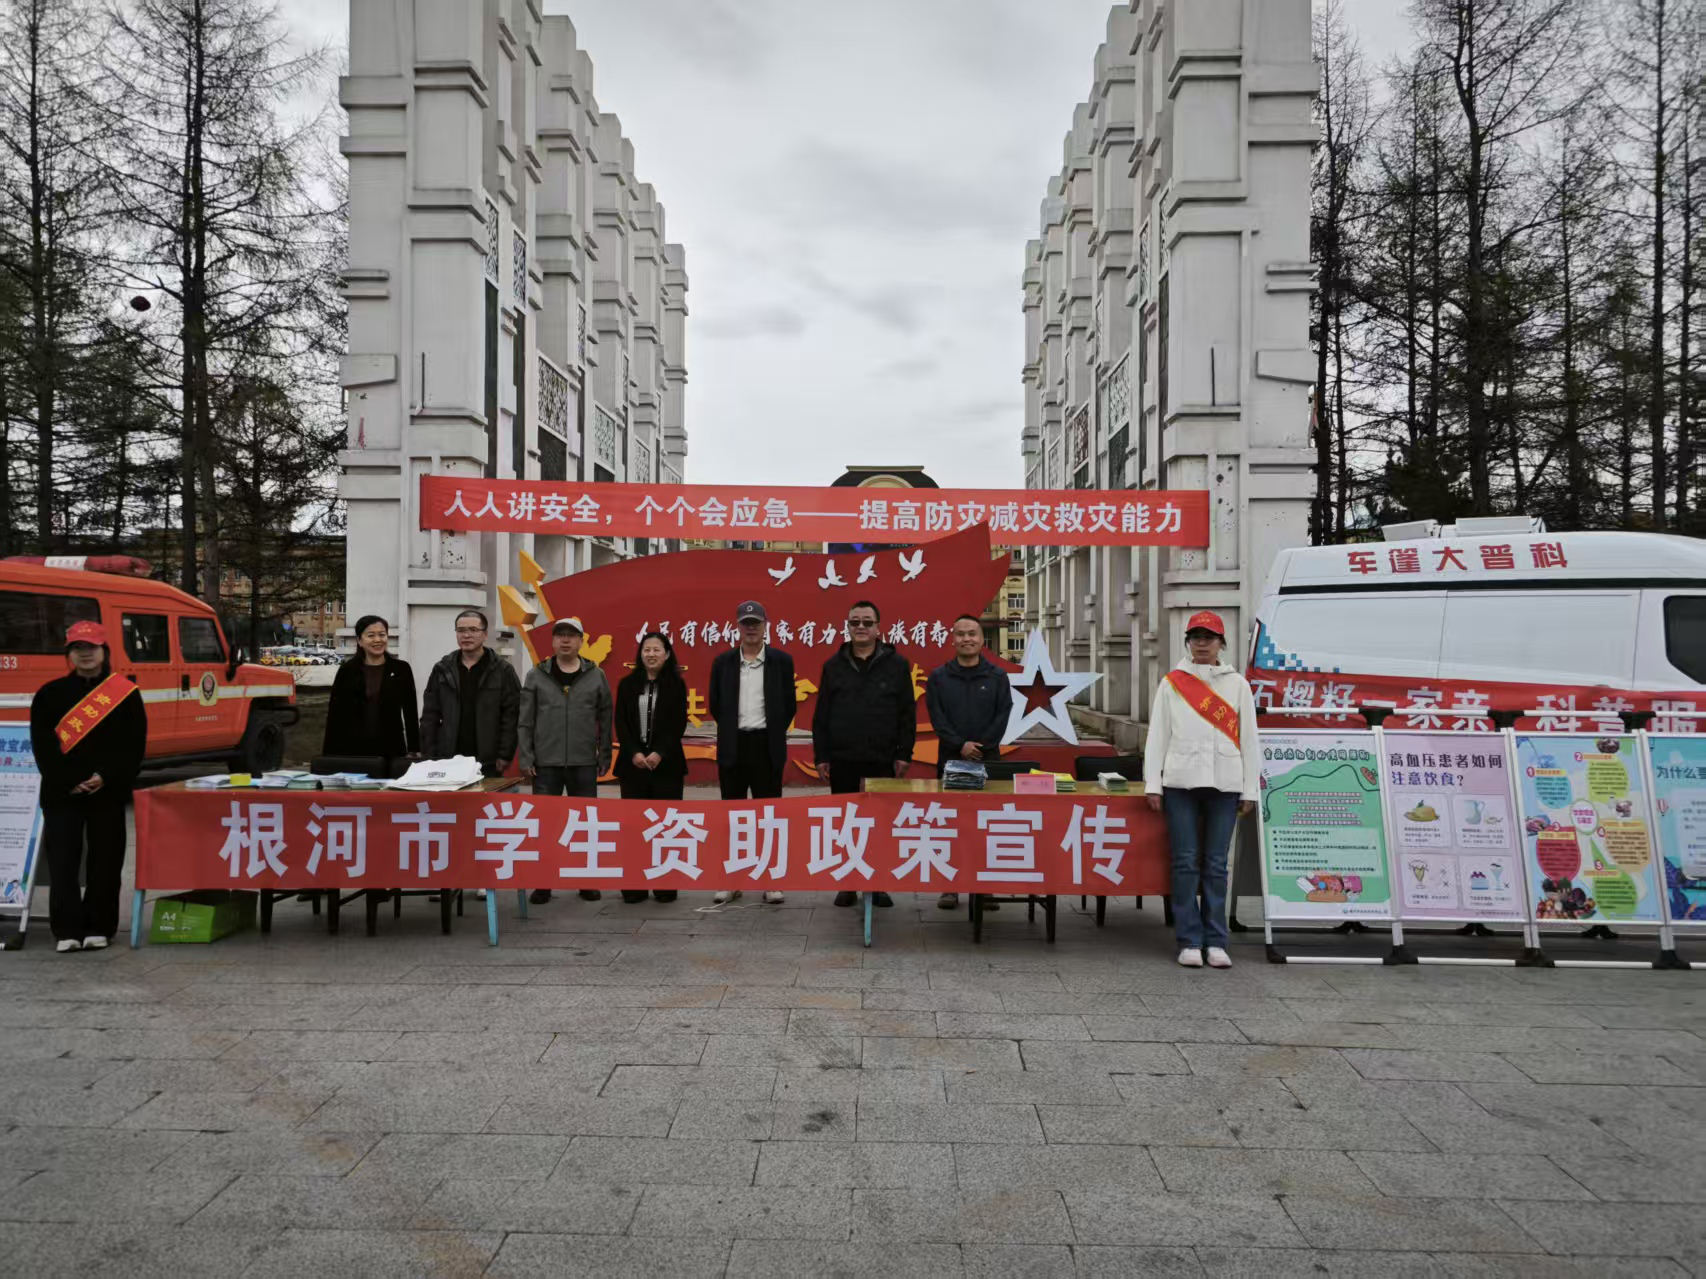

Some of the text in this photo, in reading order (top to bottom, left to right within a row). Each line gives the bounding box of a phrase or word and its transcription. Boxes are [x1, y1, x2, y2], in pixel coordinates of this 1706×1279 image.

[444, 489, 1183, 534] 人人讲安全，个个会应急——提高防灾减灾救灾能力
[1199, 696, 1239, 738] 资助政
[1389, 753, 1502, 768] 高血压患者如何
[218, 800, 1131, 885] 根河市学生资助政策宣传
